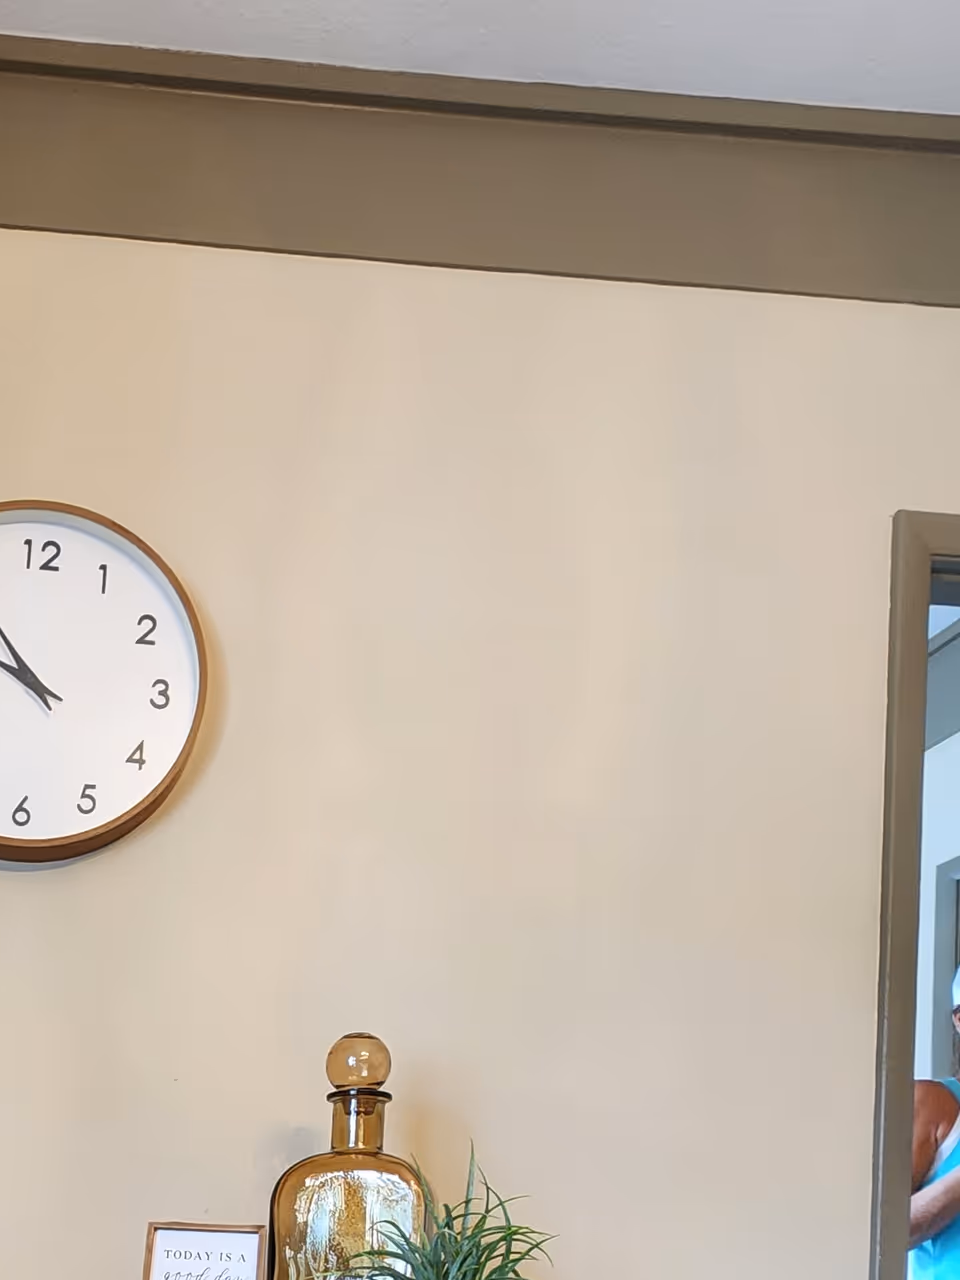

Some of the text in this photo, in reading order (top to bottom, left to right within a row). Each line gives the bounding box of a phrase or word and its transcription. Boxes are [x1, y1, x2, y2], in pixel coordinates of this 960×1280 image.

[23, 538, 62, 572] 12
[98, 563, 109, 595] 1
[135, 614, 158, 646] 2
[149, 678, 171, 710] 3
[125, 739, 147, 771] 4
[11, 795, 31, 827] 6
[76, 783, 97, 815] 5
[163, 1249, 246, 1263] TODAY IS A
